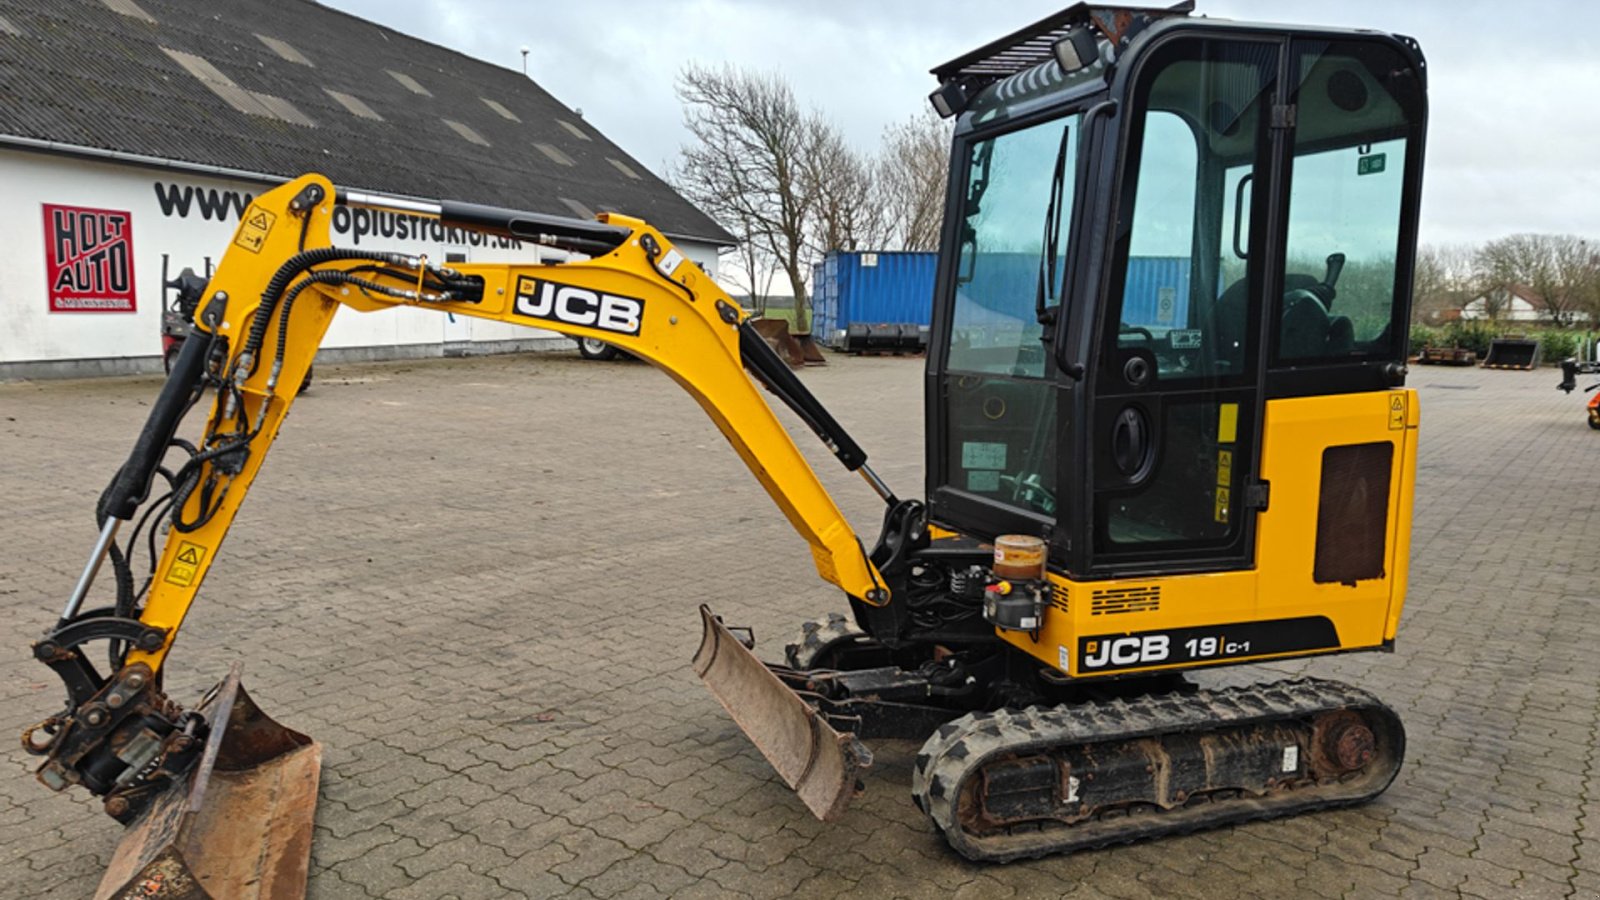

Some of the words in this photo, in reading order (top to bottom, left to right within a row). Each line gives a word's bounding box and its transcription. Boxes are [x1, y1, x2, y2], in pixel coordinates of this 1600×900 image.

[53, 209, 126, 266] HOLT
[53, 239, 130, 294] AUTO
[517, 282, 641, 333] JCB
[1084, 634, 1170, 668] JCB
[1184, 636, 1217, 657] 19
